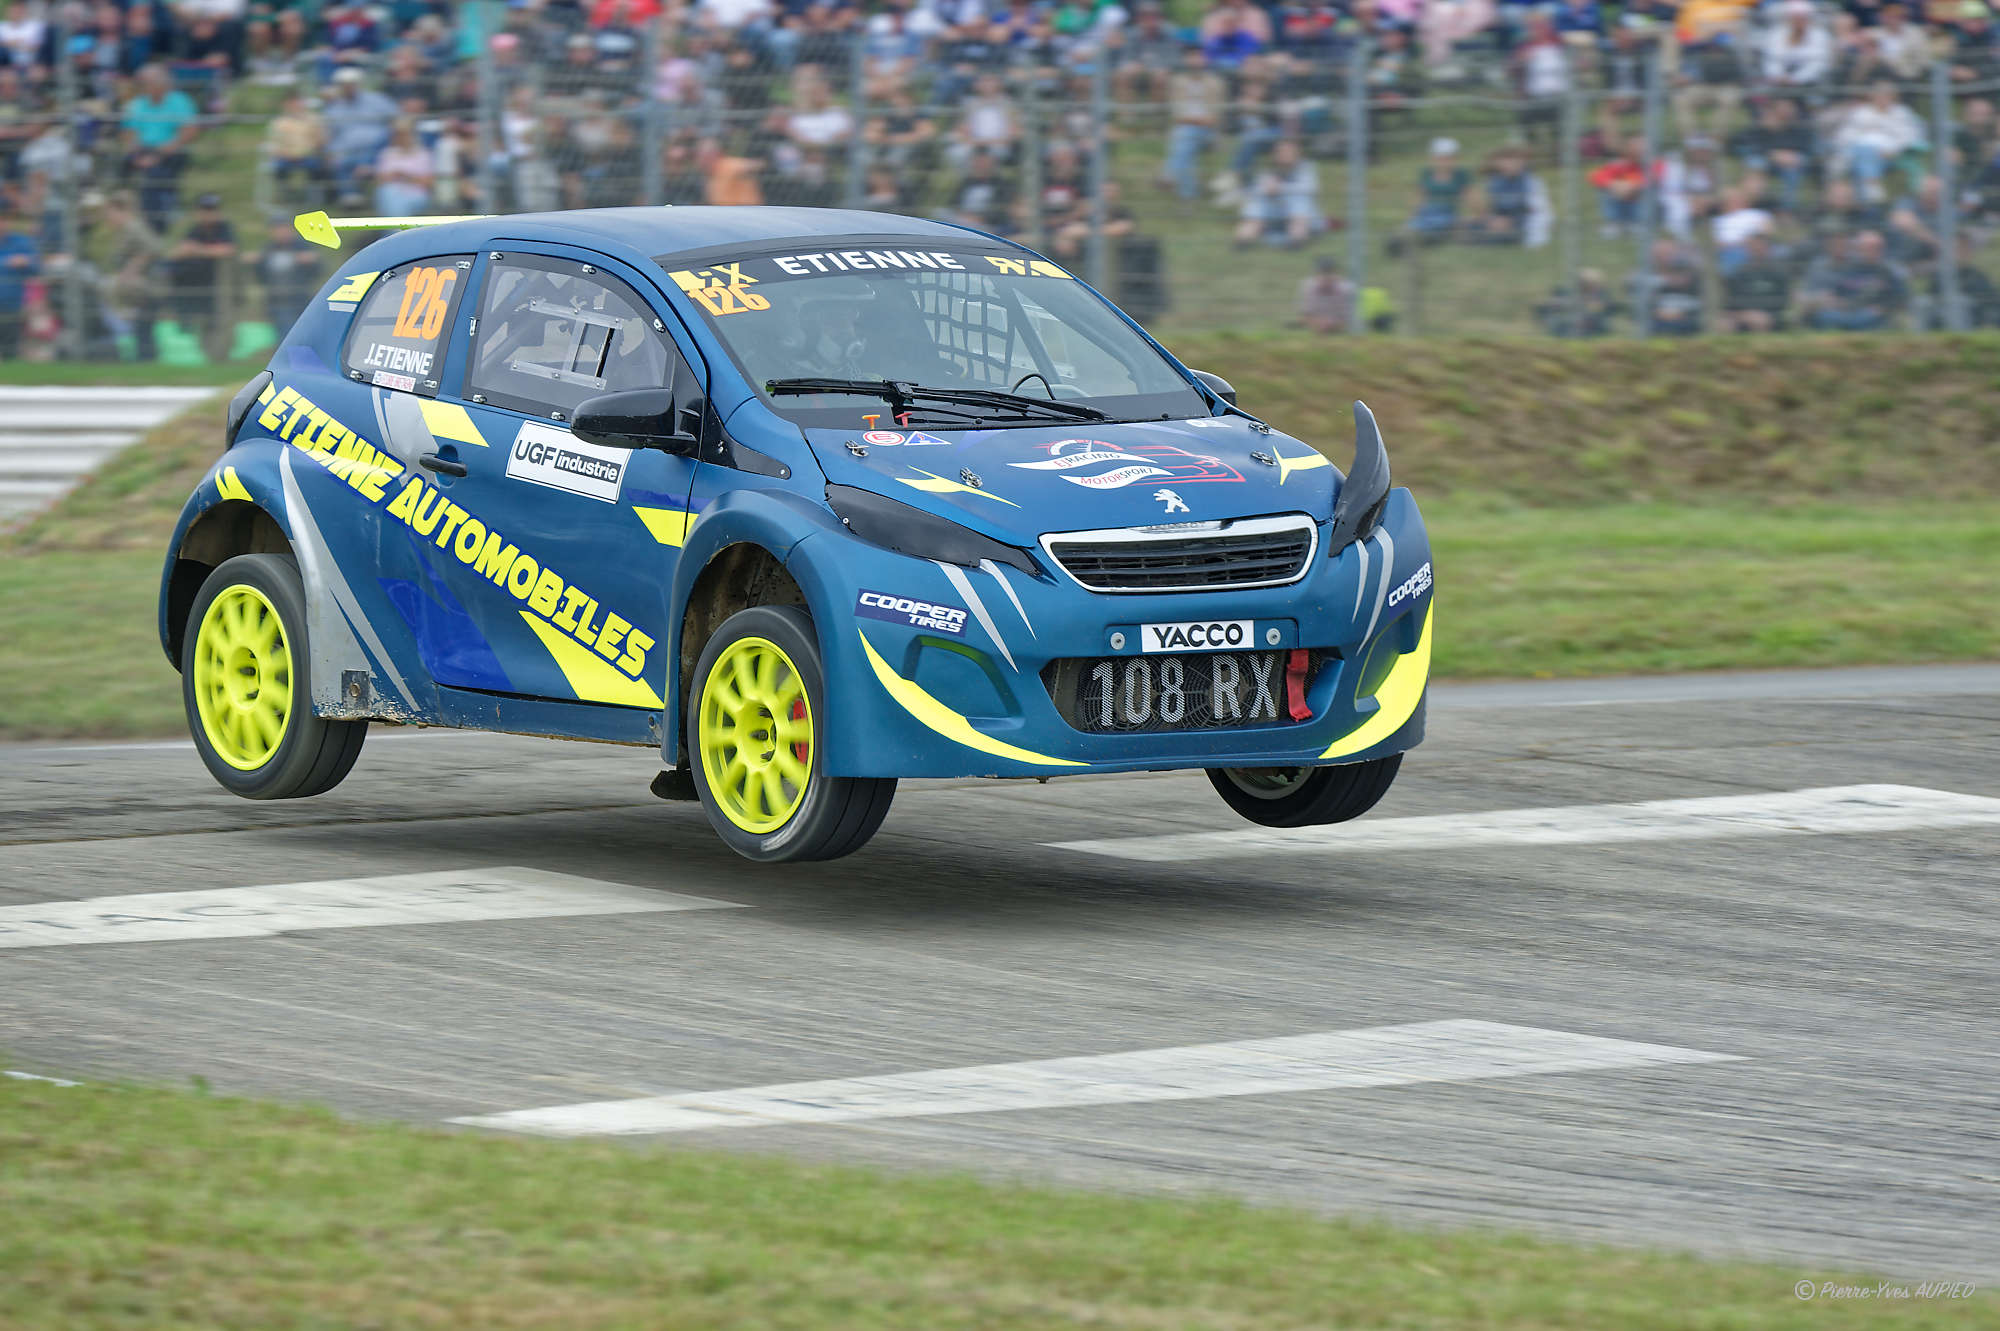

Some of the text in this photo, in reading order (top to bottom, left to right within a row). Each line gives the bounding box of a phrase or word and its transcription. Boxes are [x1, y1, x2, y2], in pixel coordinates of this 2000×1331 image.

[773, 250, 966, 275] ETIENNE
[392, 266, 457, 340] 126
[687, 283, 771, 316] 126
[364, 343, 433, 375] J.ETIENNE
[515, 440, 618, 480] UGF industrie
[1080, 468, 1153, 485] MOTORSPORT
[258, 386, 656, 678] ETIENNE AUTOMOBILES
[1389, 562, 1431, 607] COOPER
[859, 592, 967, 624] COOPER
[908, 613, 962, 633] TIRES
[1153, 623, 1243, 648] YACCO
[1092, 654, 1278, 727] 108 RX
